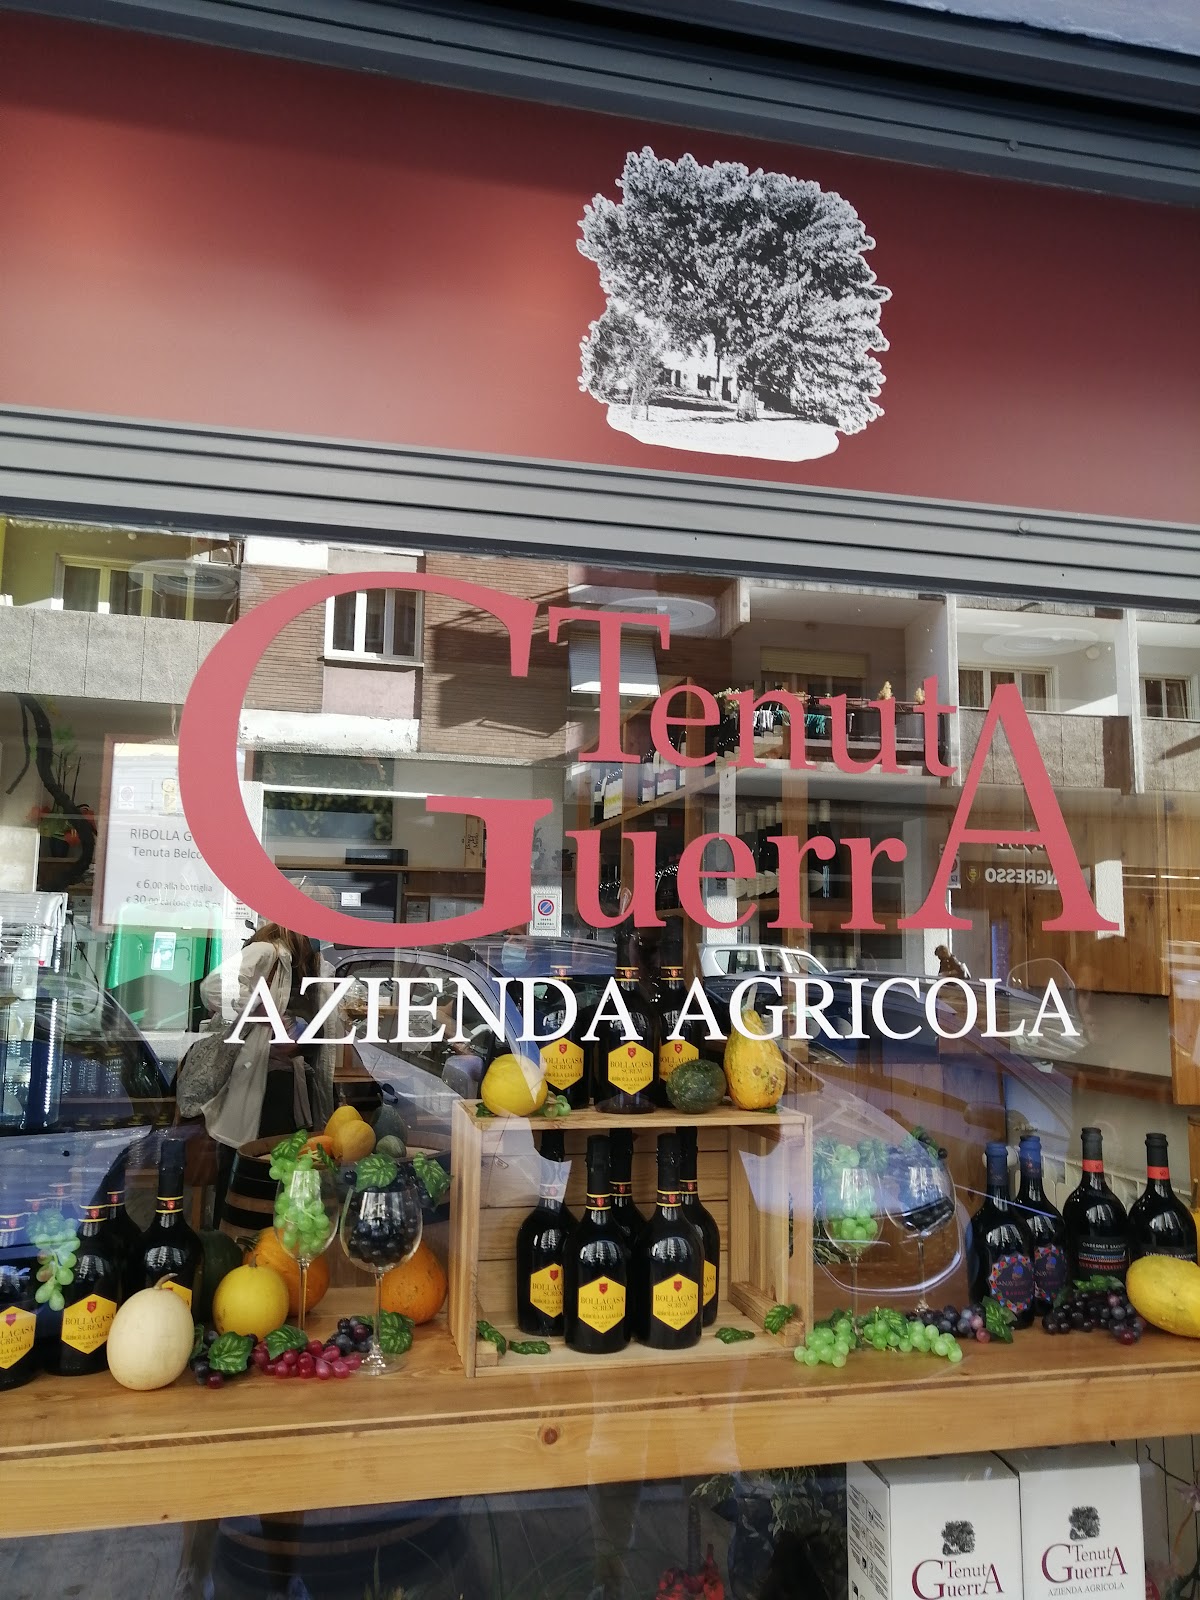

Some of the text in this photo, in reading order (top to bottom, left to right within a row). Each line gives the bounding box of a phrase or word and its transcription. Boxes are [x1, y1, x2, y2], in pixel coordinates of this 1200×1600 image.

[130, 828, 180, 841] RIBOLLA
[132, 846, 170, 858] Tenuta
[164, 882, 178, 890] alla
[180, 883, 213, 893] bottiglia
[160, 898, 192, 907] cartone
[224, 976, 1082, 1045] AZIENDA AGRICOLA
[580, 1296, 625, 1305] BOLLACASA
[655, 1294, 698, 1302] BOLLACASA
[1047, 1581, 1126, 1597] AZIENDA AGRICOLA
